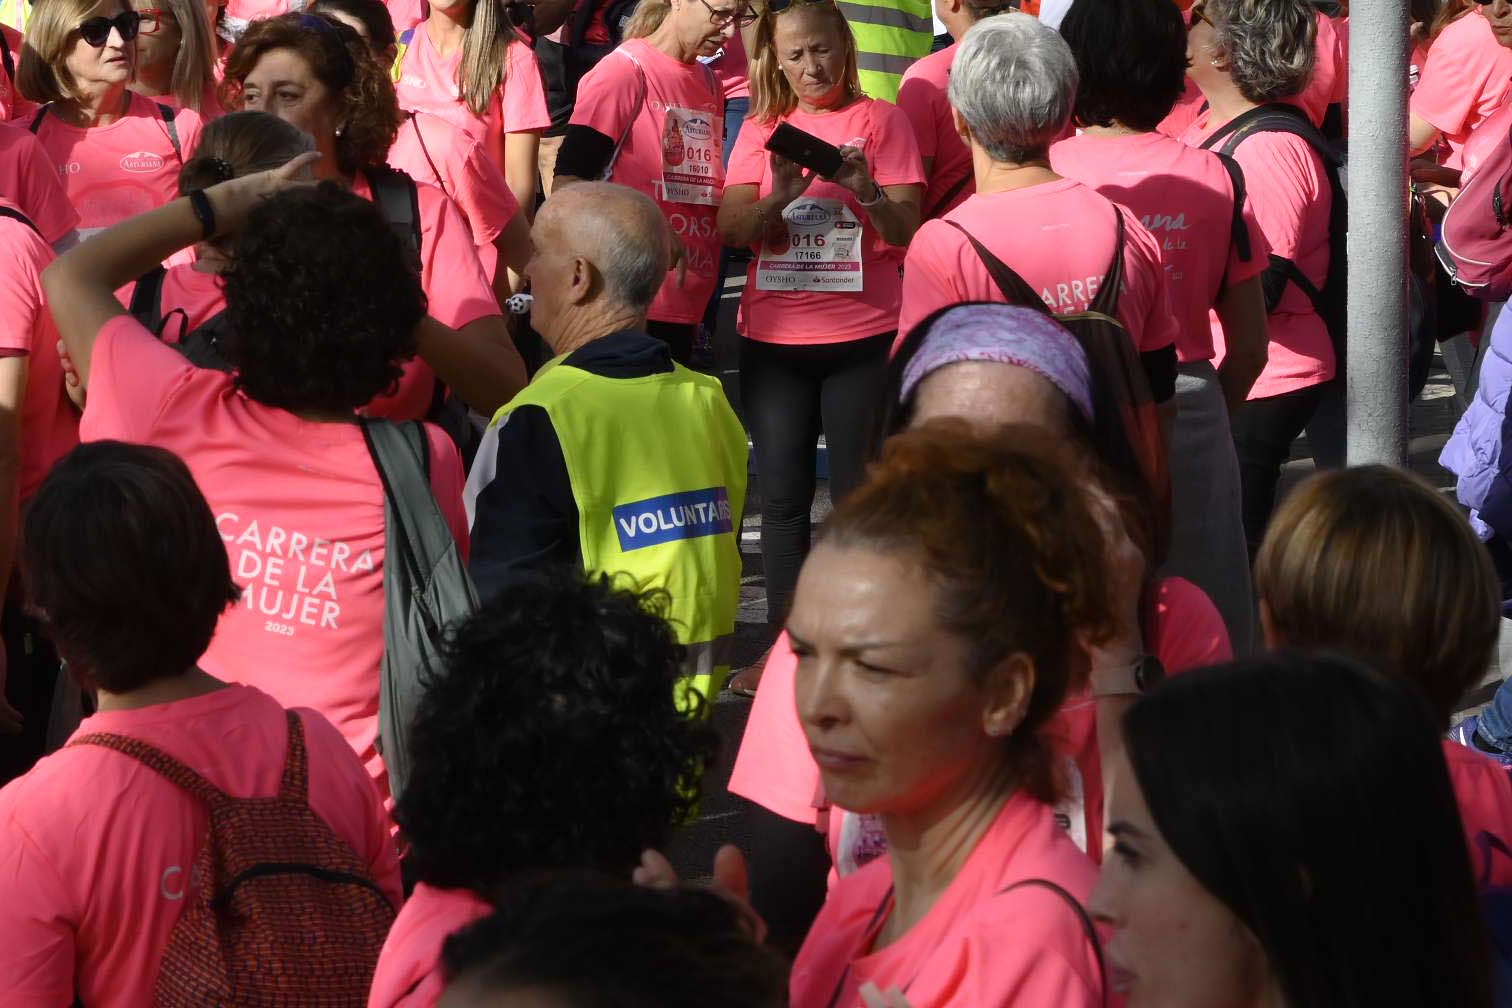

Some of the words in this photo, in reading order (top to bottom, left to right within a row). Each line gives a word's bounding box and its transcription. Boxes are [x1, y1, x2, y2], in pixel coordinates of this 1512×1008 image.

[687, 147, 712, 162] 016
[792, 233, 826, 247] 016
[765, 275, 796, 284] OYSHO
[216, 512, 374, 573] CARRERA
[239, 548, 284, 586] DE
[296, 565, 338, 600] LA
[265, 621, 295, 637] 2023
